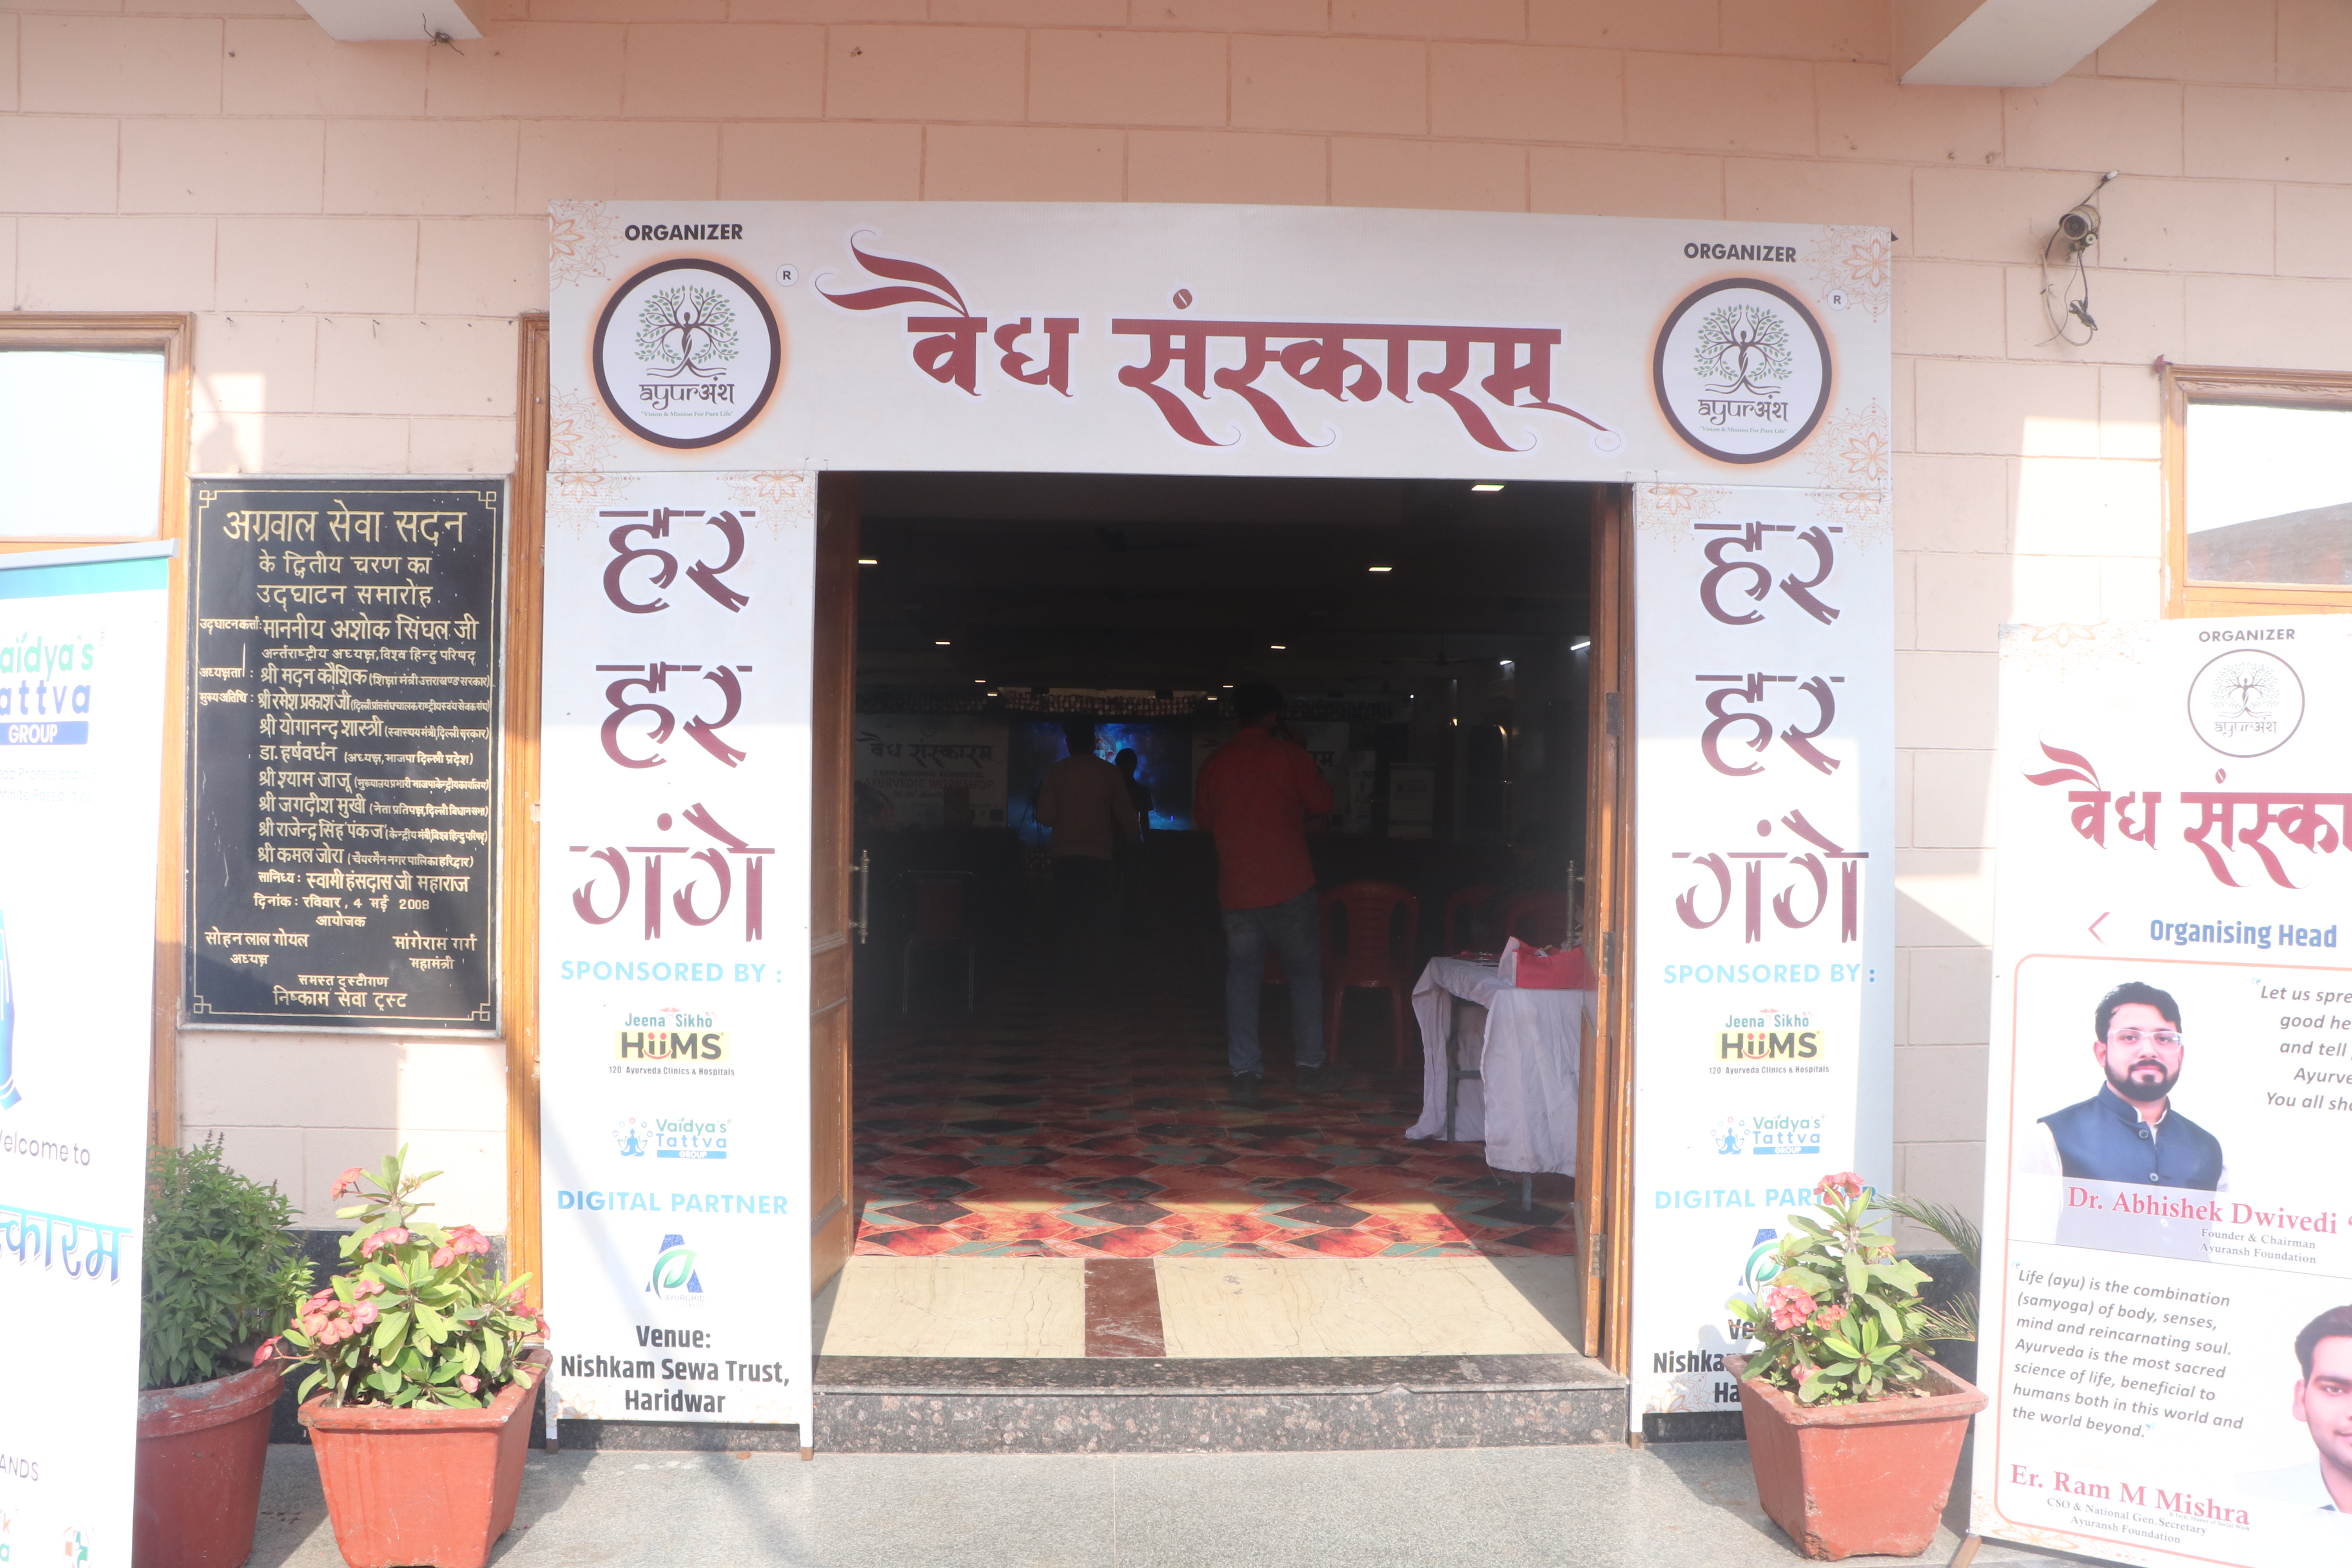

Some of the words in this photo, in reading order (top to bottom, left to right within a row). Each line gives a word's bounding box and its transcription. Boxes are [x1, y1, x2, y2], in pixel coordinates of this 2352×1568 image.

[625, 224, 742, 241] ORGANIZER
[1684, 243, 1796, 262] ORGANIZER
[1111, 288, 1609, 452] संस्कारम
[223, 510, 318, 541] अग्रवाल
[327, 499, 384, 542] सेवा
[393, 511, 467, 546] सदन
[259, 549, 276, 572] के
[350, 557, 402, 573] चरण
[407, 557, 432, 574] का
[599, 507, 756, 614] हर
[1694, 521, 1843, 626] हर
[354, 578, 433, 608] समारोह
[262, 613, 326, 639] माननीय
[330, 612, 392, 641] अशोक
[395, 613, 451, 640] सिंघल
[454, 613, 479, 640] जी
[2199, 629, 2295, 642] ORGANIZER
[0, 630, 94, 682] aidya's
[261, 662, 279, 684] श्री
[281, 668, 316, 688] मदन
[318, 662, 368, 686] कौशिक
[0, 680, 91, 716] attva
[260, 713, 278, 735] श्री
[341, 715, 384, 737] शास्त्री
[596, 662, 753, 769] हर
[1695, 672, 1845, 776] हर
[9, 724, 58, 743] GROUP
[260, 745, 278, 760] डा.
[19, 767, 87, 780] Professionals
[929, 779, 994, 789] WORKSHOP
[33, 788, 92, 802] Possibilities
[2180, 769, 2352, 889] संस्का
[258, 842, 276, 862] श्री
[277, 848, 314, 863] कमल
[315, 842, 345, 863] जोरा
[570, 802, 775, 942] गंगे
[1672, 809, 1868, 944] गंगे
[353, 898, 362, 908] 4
[369, 895, 389, 912] मई
[399, 899, 430, 910] 2008
[316, 911, 367, 927] आयोजक
[2151, 920, 2271, 949] Organising
[2279, 925, 2336, 947] Head
[230, 954, 269, 967] अध्यक्ष
[409, 955, 455, 971] महामंत्री
[561, 960, 723, 981] SPONSORED
[735, 964, 766, 982] BY
[1664, 964, 1820, 984] SPONSORED
[1831, 964, 1861, 982] BY
[272, 985, 330, 1006] निष्काम
[335, 987, 367, 1007] सेवा
[373, 993, 407, 1011] ट्रस्ट
[2261, 986, 2287, 1000] Let
[2292, 991, 2310, 1000] us
[2316, 991, 2352, 1005] spre
[624, 1013, 665, 1027] Jeena
[675, 1013, 712, 1028] Sikho
[1726, 1015, 1764, 1027] Jeena
[1774, 1014, 1809, 1027] Sikho
[2280, 1015, 2325, 1029] good
[2280, 1041, 2314, 1054] and
[2319, 1042, 2347, 1056] tell
[2293, 1068, 2352, 1084] Ayurve
[2267, 1092, 2296, 1107] You
[2302, 1095, 2324, 1109] all
[0, 1130, 68, 1162] elcome
[74, 1143, 90, 1166] to
[655, 1133, 726, 1148] Tattva
[1753, 1131, 1820, 1144] Tattva
[558, 1191, 661, 1210] DIGITAL
[672, 1194, 787, 1214] PARTNER
[1655, 1189, 1755, 1209] DIGITAL
[2067, 1186, 2103, 1210] Dr.
[2112, 1191, 2223, 1220] Abhishek
[2230, 1203, 2337, 1234] Dwivedi
[2201, 1228, 2245, 1241] Founder
[2248, 1234, 2257, 1242] &
[2261, 1235, 2316, 1249] Chairman
[2200, 1243, 2250, 1256] Ayuransh
[2254, 1249, 2316, 1263] Foundation
[2019, 1270, 2043, 1285] Life
[2048, 1272, 2085, 1290] (ayu)
[2089, 1278, 2100, 1290] is
[2105, 1280, 2129, 1294] the
[2134, 1287, 2230, 1306] combination
[636, 1326, 710, 1348] Venue:
[2016, 1317, 2053, 1330] mind
[2057, 1323, 2085, 1334] and
[2089, 1327, 2190, 1352] reincarnating
[2195, 1342, 2230, 1355] soul.
[562, 1354, 655, 1379] Nishkam
[662, 1358, 718, 1380] Sewa
[725, 1361, 789, 1387] Trust,
[1654, 1350, 1743, 1373] Nishka
[2014, 1363, 2065, 1378] science
[2070, 1370, 2086, 1383] of
[2089, 1371, 2115, 1388] life,
[2121, 1376, 2195, 1397] beneficial
[2200, 1389, 2215, 1400] to
[625, 1388, 725, 1412] Haridwar
[2010, 1464, 2043, 1488] Er.
[2053, 1471, 2111, 1499] Ram
[2118, 1482, 2147, 1506] M
[2155, 1488, 2250, 1525] Mishra
[2047, 1498, 2070, 1508] CSO
[2073, 1503, 2082, 1511] &
[2085, 1504, 2129, 1519] National
[2070, 1516, 2118, 1531] Ayuransh
[2122, 1525, 2181, 1544] Foundation
